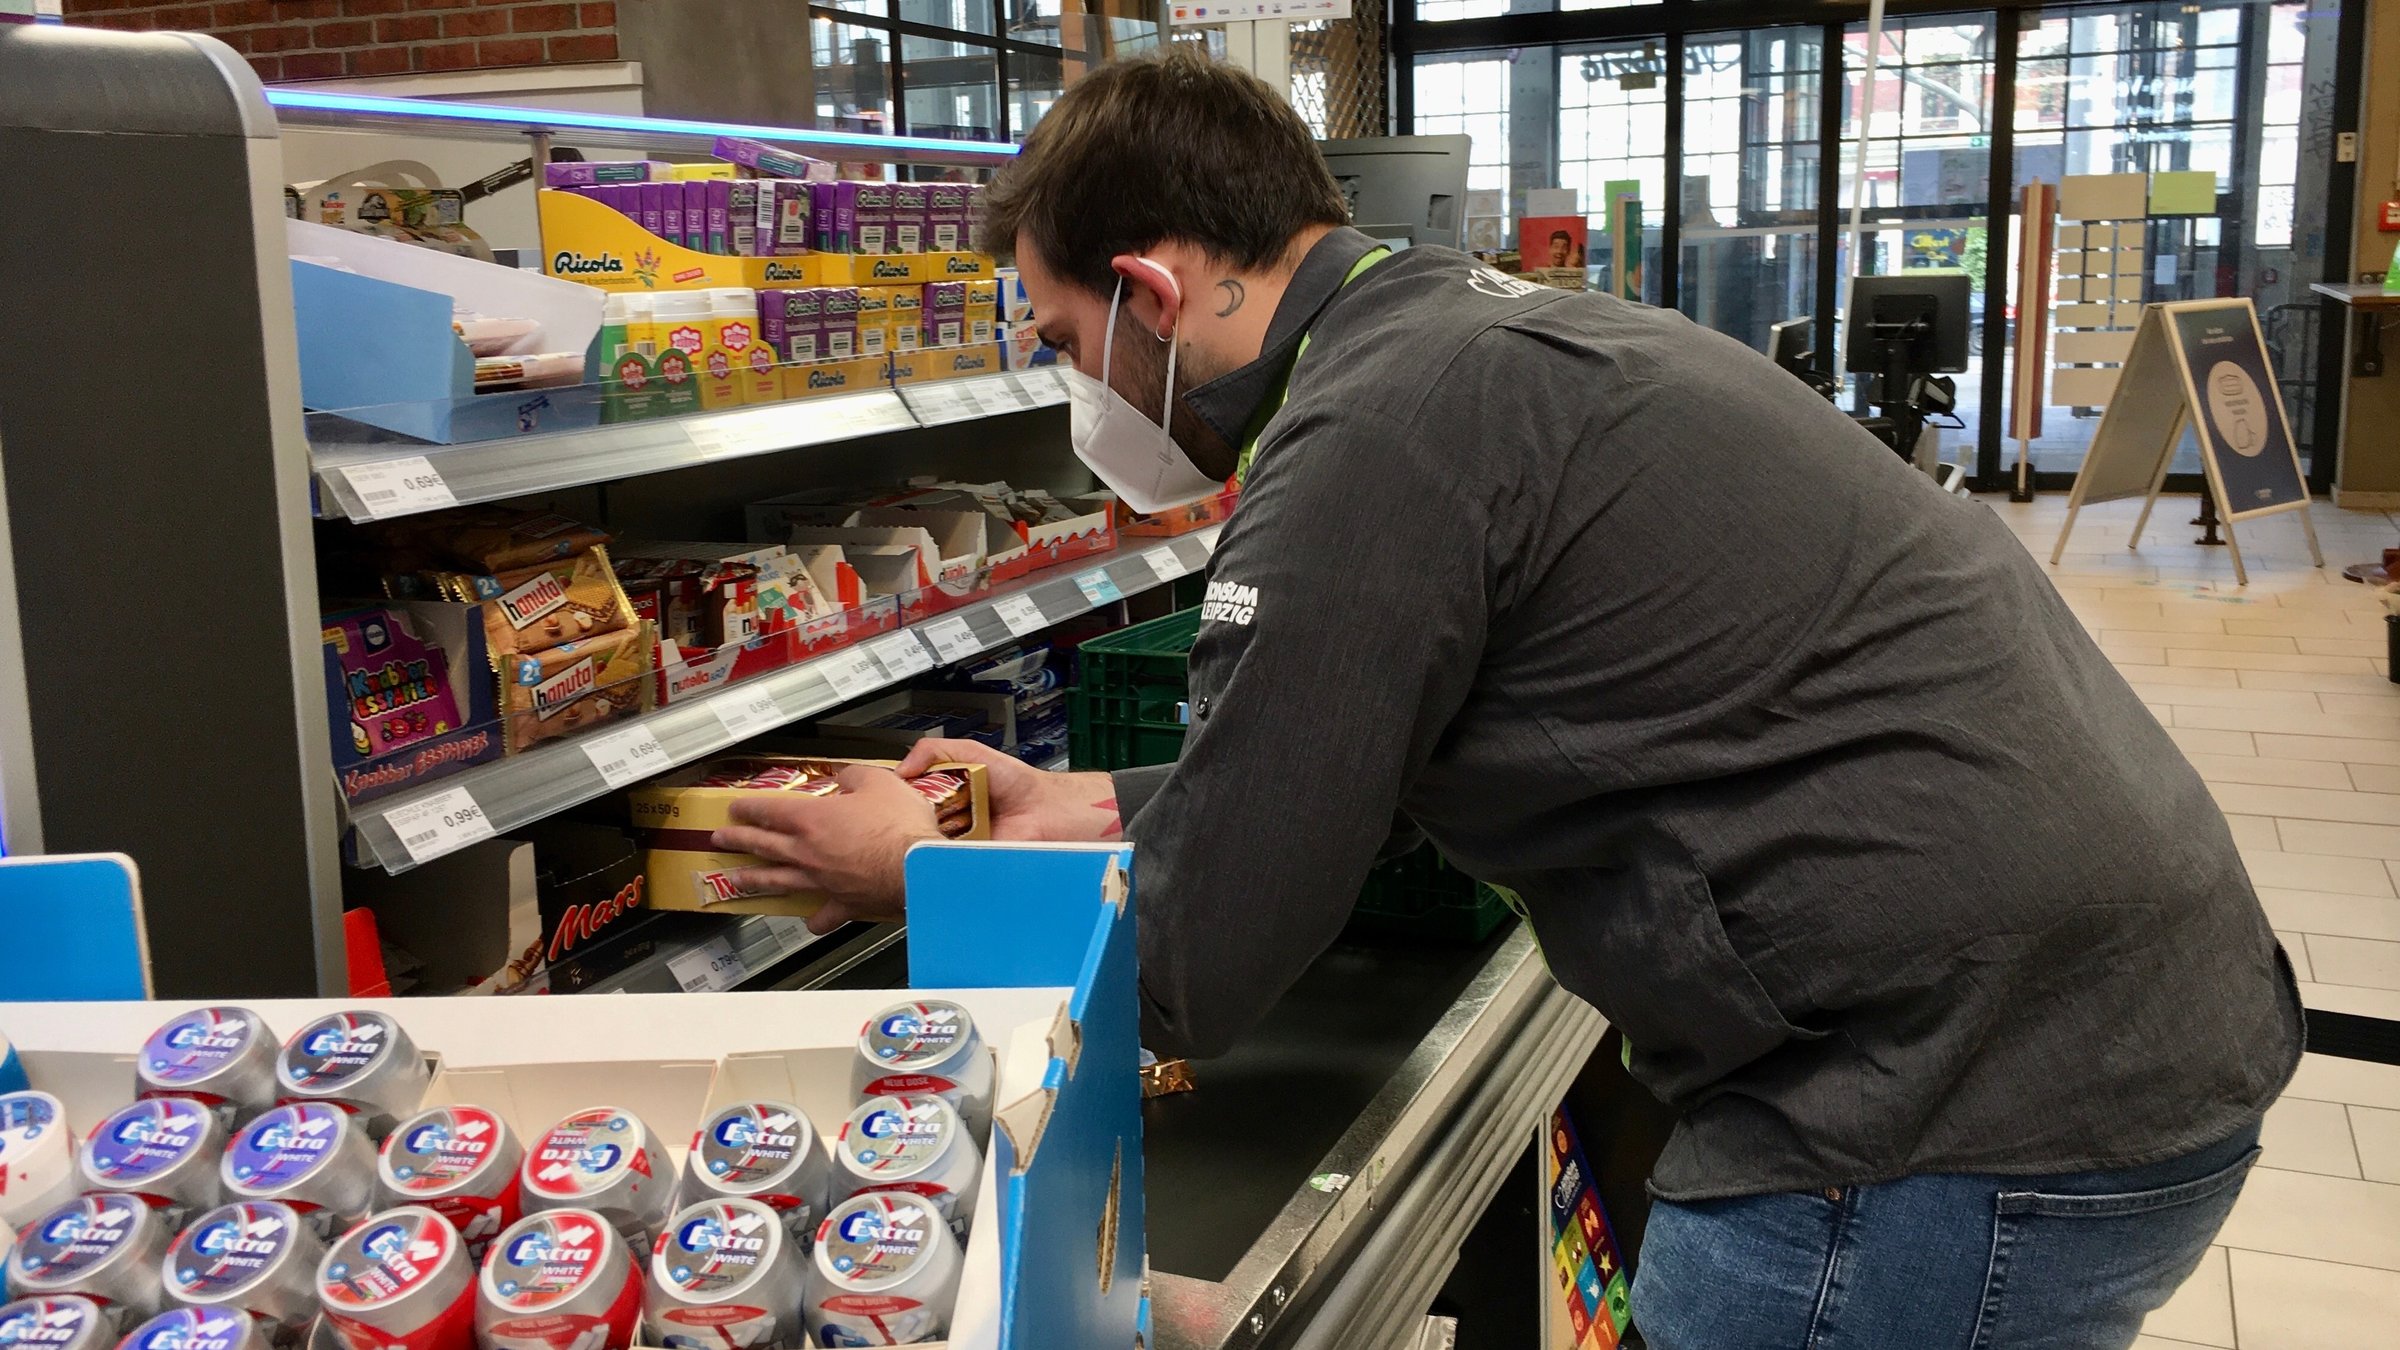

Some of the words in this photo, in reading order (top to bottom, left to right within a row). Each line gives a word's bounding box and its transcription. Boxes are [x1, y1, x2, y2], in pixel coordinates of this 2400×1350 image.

[554, 251, 623, 274] Ricola
[765, 262, 804, 282] Ricola
[873, 259, 910, 279] Ricola
[946, 256, 981, 275] Ricola
[953, 354, 986, 372] Ricola
[808, 369, 846, 390] Ricola
[403, 473, 444, 491] 0,69€
[503, 580, 561, 621] hanuta
[1200, 601, 1255, 625] LEIPZIG
[536, 665, 592, 708] hanuta
[671, 669, 710, 695] nutella
[629, 740, 663, 759] 0,69€
[345, 763, 413, 797] Knabber
[443, 804, 483, 828] 0,99€
[548, 874, 645, 962] Mars
[711, 951, 741, 973] 0,79€
[886, 1019, 958, 1036] Extra
[172, 1028, 241, 1048] Extra
[309, 1034, 380, 1054] Extra
[914, 1036, 954, 1044] WHITE
[330, 1056, 370, 1066] WHITE
[723, 1122, 798, 1147] Extra
[869, 1116, 942, 1134] Extra
[119, 1126, 191, 1148] Extra
[256, 1127, 328, 1150] Extra
[413, 1130, 488, 1153] Extra
[897, 1137, 937, 1145] WHITE
[134, 1146, 178, 1159] WHITE
[274, 1150, 317, 1163] WHITE
[436, 1155, 478, 1166] WHITE
[540, 1148, 615, 1168] Extra
[749, 1149, 792, 1161] WHITE
[49, 1219, 124, 1241] Extra
[687, 1225, 764, 1251] Extra
[848, 1217, 924, 1242] Extra
[202, 1227, 278, 1254] Extra
[514, 1239, 593, 1262] Extra
[874, 1243, 919, 1256] WHITE
[220, 1256, 266, 1269] WHITE
[367, 1231, 421, 1282] Extra
[713, 1252, 758, 1265] WHITE
[369, 1267, 401, 1294] WHITE
[541, 1265, 585, 1276] WHITE
[0, 1318, 74, 1341] Extra
[150, 1330, 230, 1350] Extra
